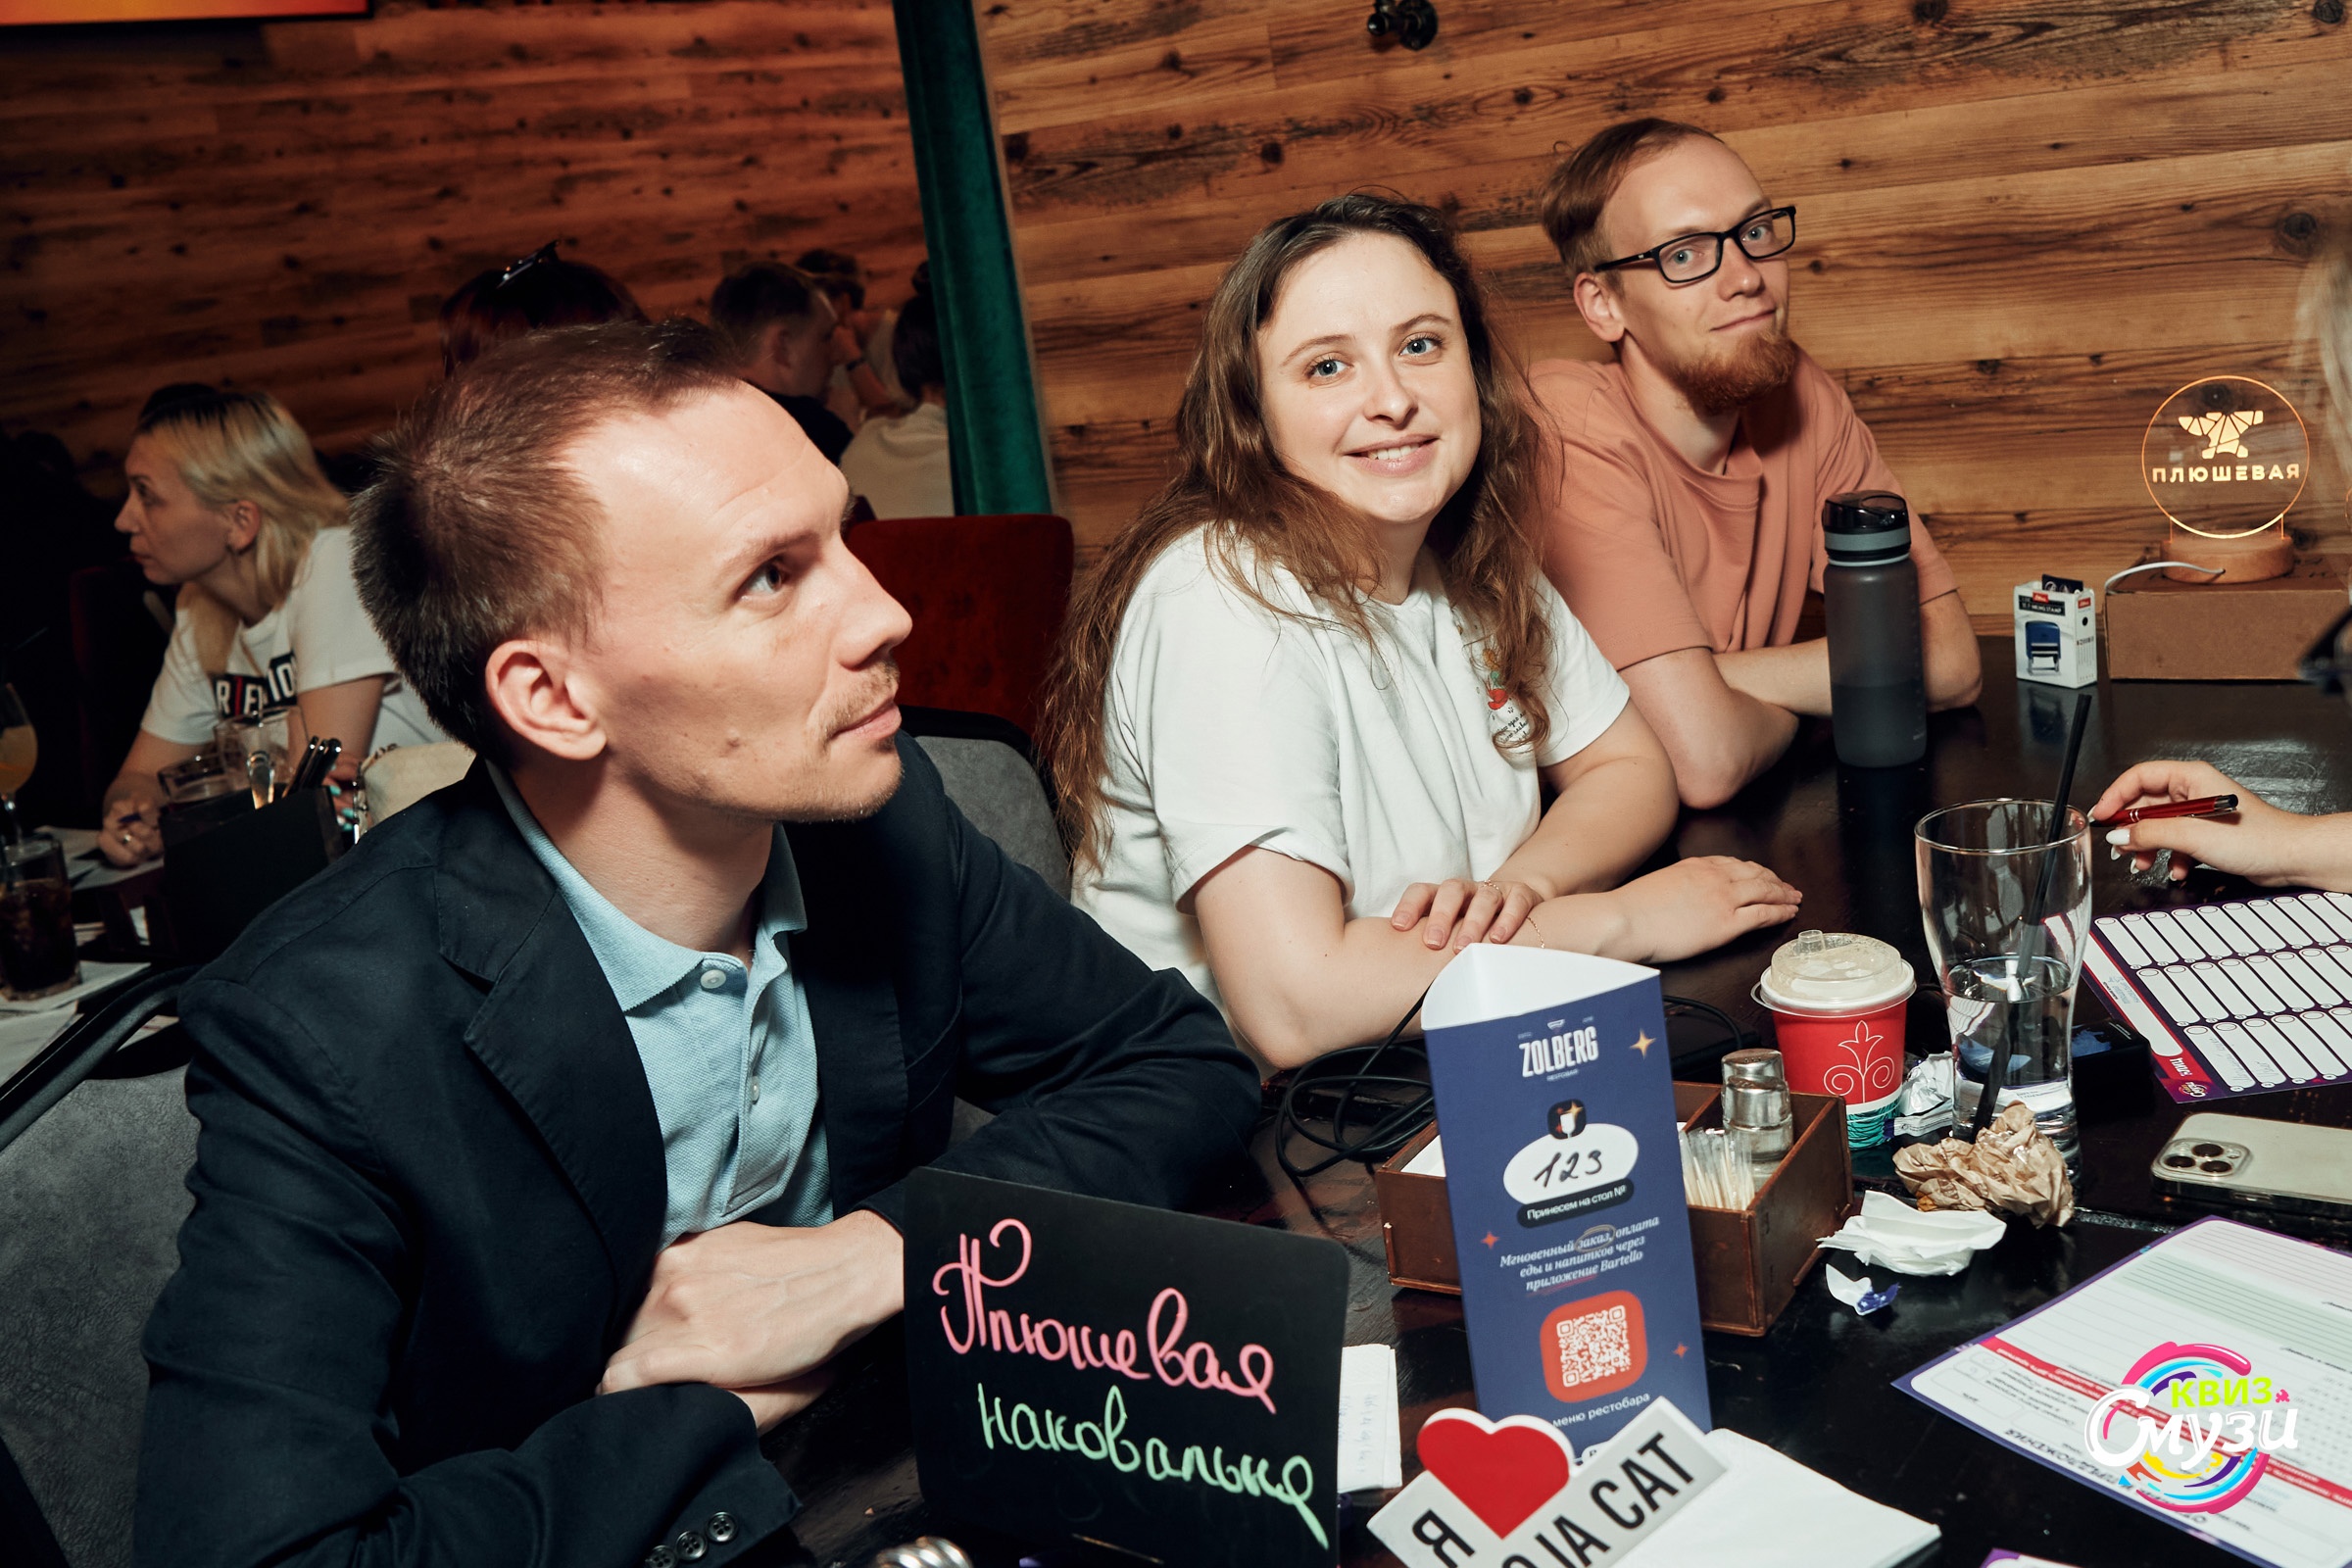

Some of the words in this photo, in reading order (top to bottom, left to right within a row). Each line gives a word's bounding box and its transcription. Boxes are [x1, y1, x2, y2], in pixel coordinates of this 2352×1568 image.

[2152, 463, 2300, 483] ПЛЮШЕВАЯ
[1519, 1026, 1599, 1078] ZOLBERG
[1534, 1149, 1603, 1189] 123
[1526, 1200, 1578, 1221] Принесем
[1578, 1197, 1591, 1208] на
[1592, 1191, 1614, 1204] стол
[1499, 1239, 1576, 1268] Мгновенный
[1577, 1233, 1614, 1250] заказ,
[1615, 1216, 1660, 1238] оплата
[1520, 1265, 1544, 1278] еды
[1544, 1263, 1553, 1272] и
[1554, 1245, 1614, 1270] напитков
[1615, 1236, 1645, 1254] через
[1526, 1266, 1598, 1292] приложение
[1600, 1250, 1643, 1272] Bartello
[1552, 1412, 1586, 1428] меню
[1588, 1393, 1650, 1423] рестобара
[1590, 1432, 1694, 1530] CAT
[1412, 1508, 1476, 1568] Я
